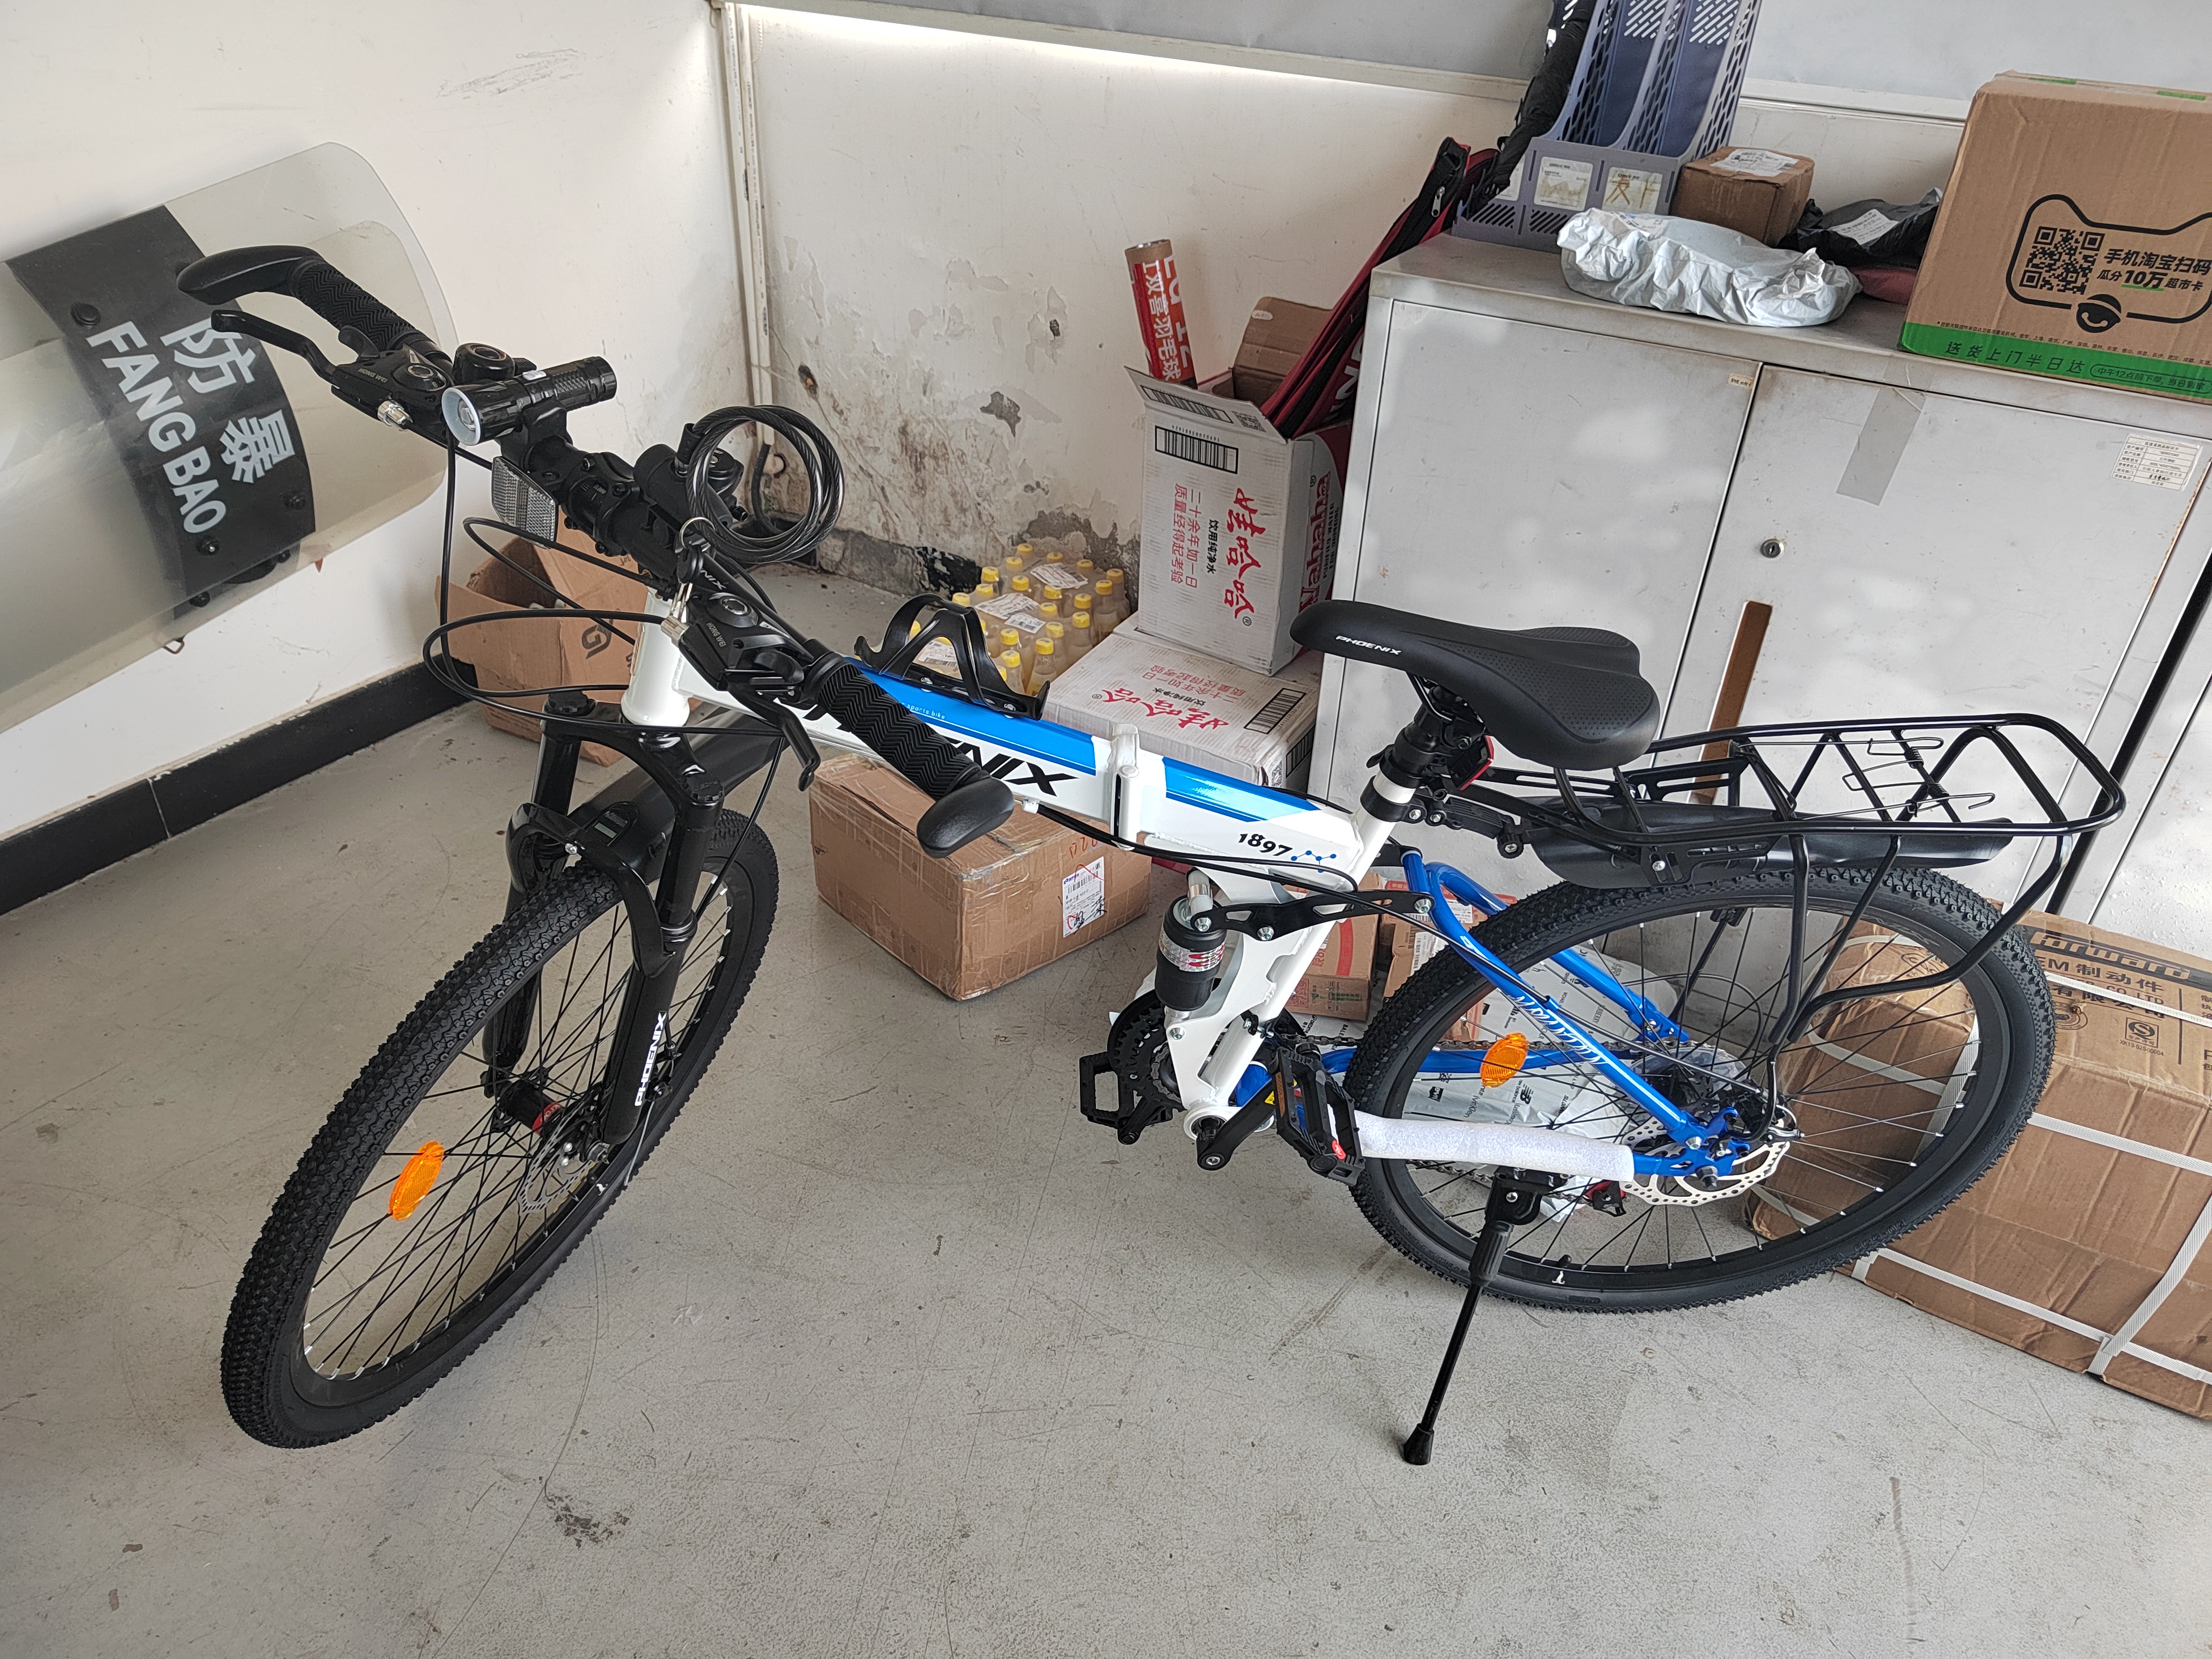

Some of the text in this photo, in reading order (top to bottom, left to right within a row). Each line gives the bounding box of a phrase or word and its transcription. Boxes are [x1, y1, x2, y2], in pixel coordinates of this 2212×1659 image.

[2104, 249, 2212, 276] 手机淘宝扫码
[1945, 341, 2086, 374] 送货上门半日达
[358, 368, 388, 384] HONG WEI
[86, 321, 227, 534] FANG BAO
[1171, 483, 1188, 584] 质量经得起考验
[1185, 488, 1202, 589] 二十余年如一日
[1206, 519, 1219, 574] 饮用纯净水
[1224, 488, 1266, 619] 娃哈哈
[706, 622, 727, 648] HONG WEI
[1335, 635, 1402, 655] PHOENIX
[1142, 672, 1240, 704] 二十余年如一日
[1150, 664, 1248, 697] 质量经得起考验
[907, 703, 945, 720] sports bike
[1102, 687, 1230, 730] 娃哈哈
[1239, 832, 1292, 858] 1897
[2075, 964, 2164, 992] 制动件
[634, 1012, 667, 1107] PHOENIX
